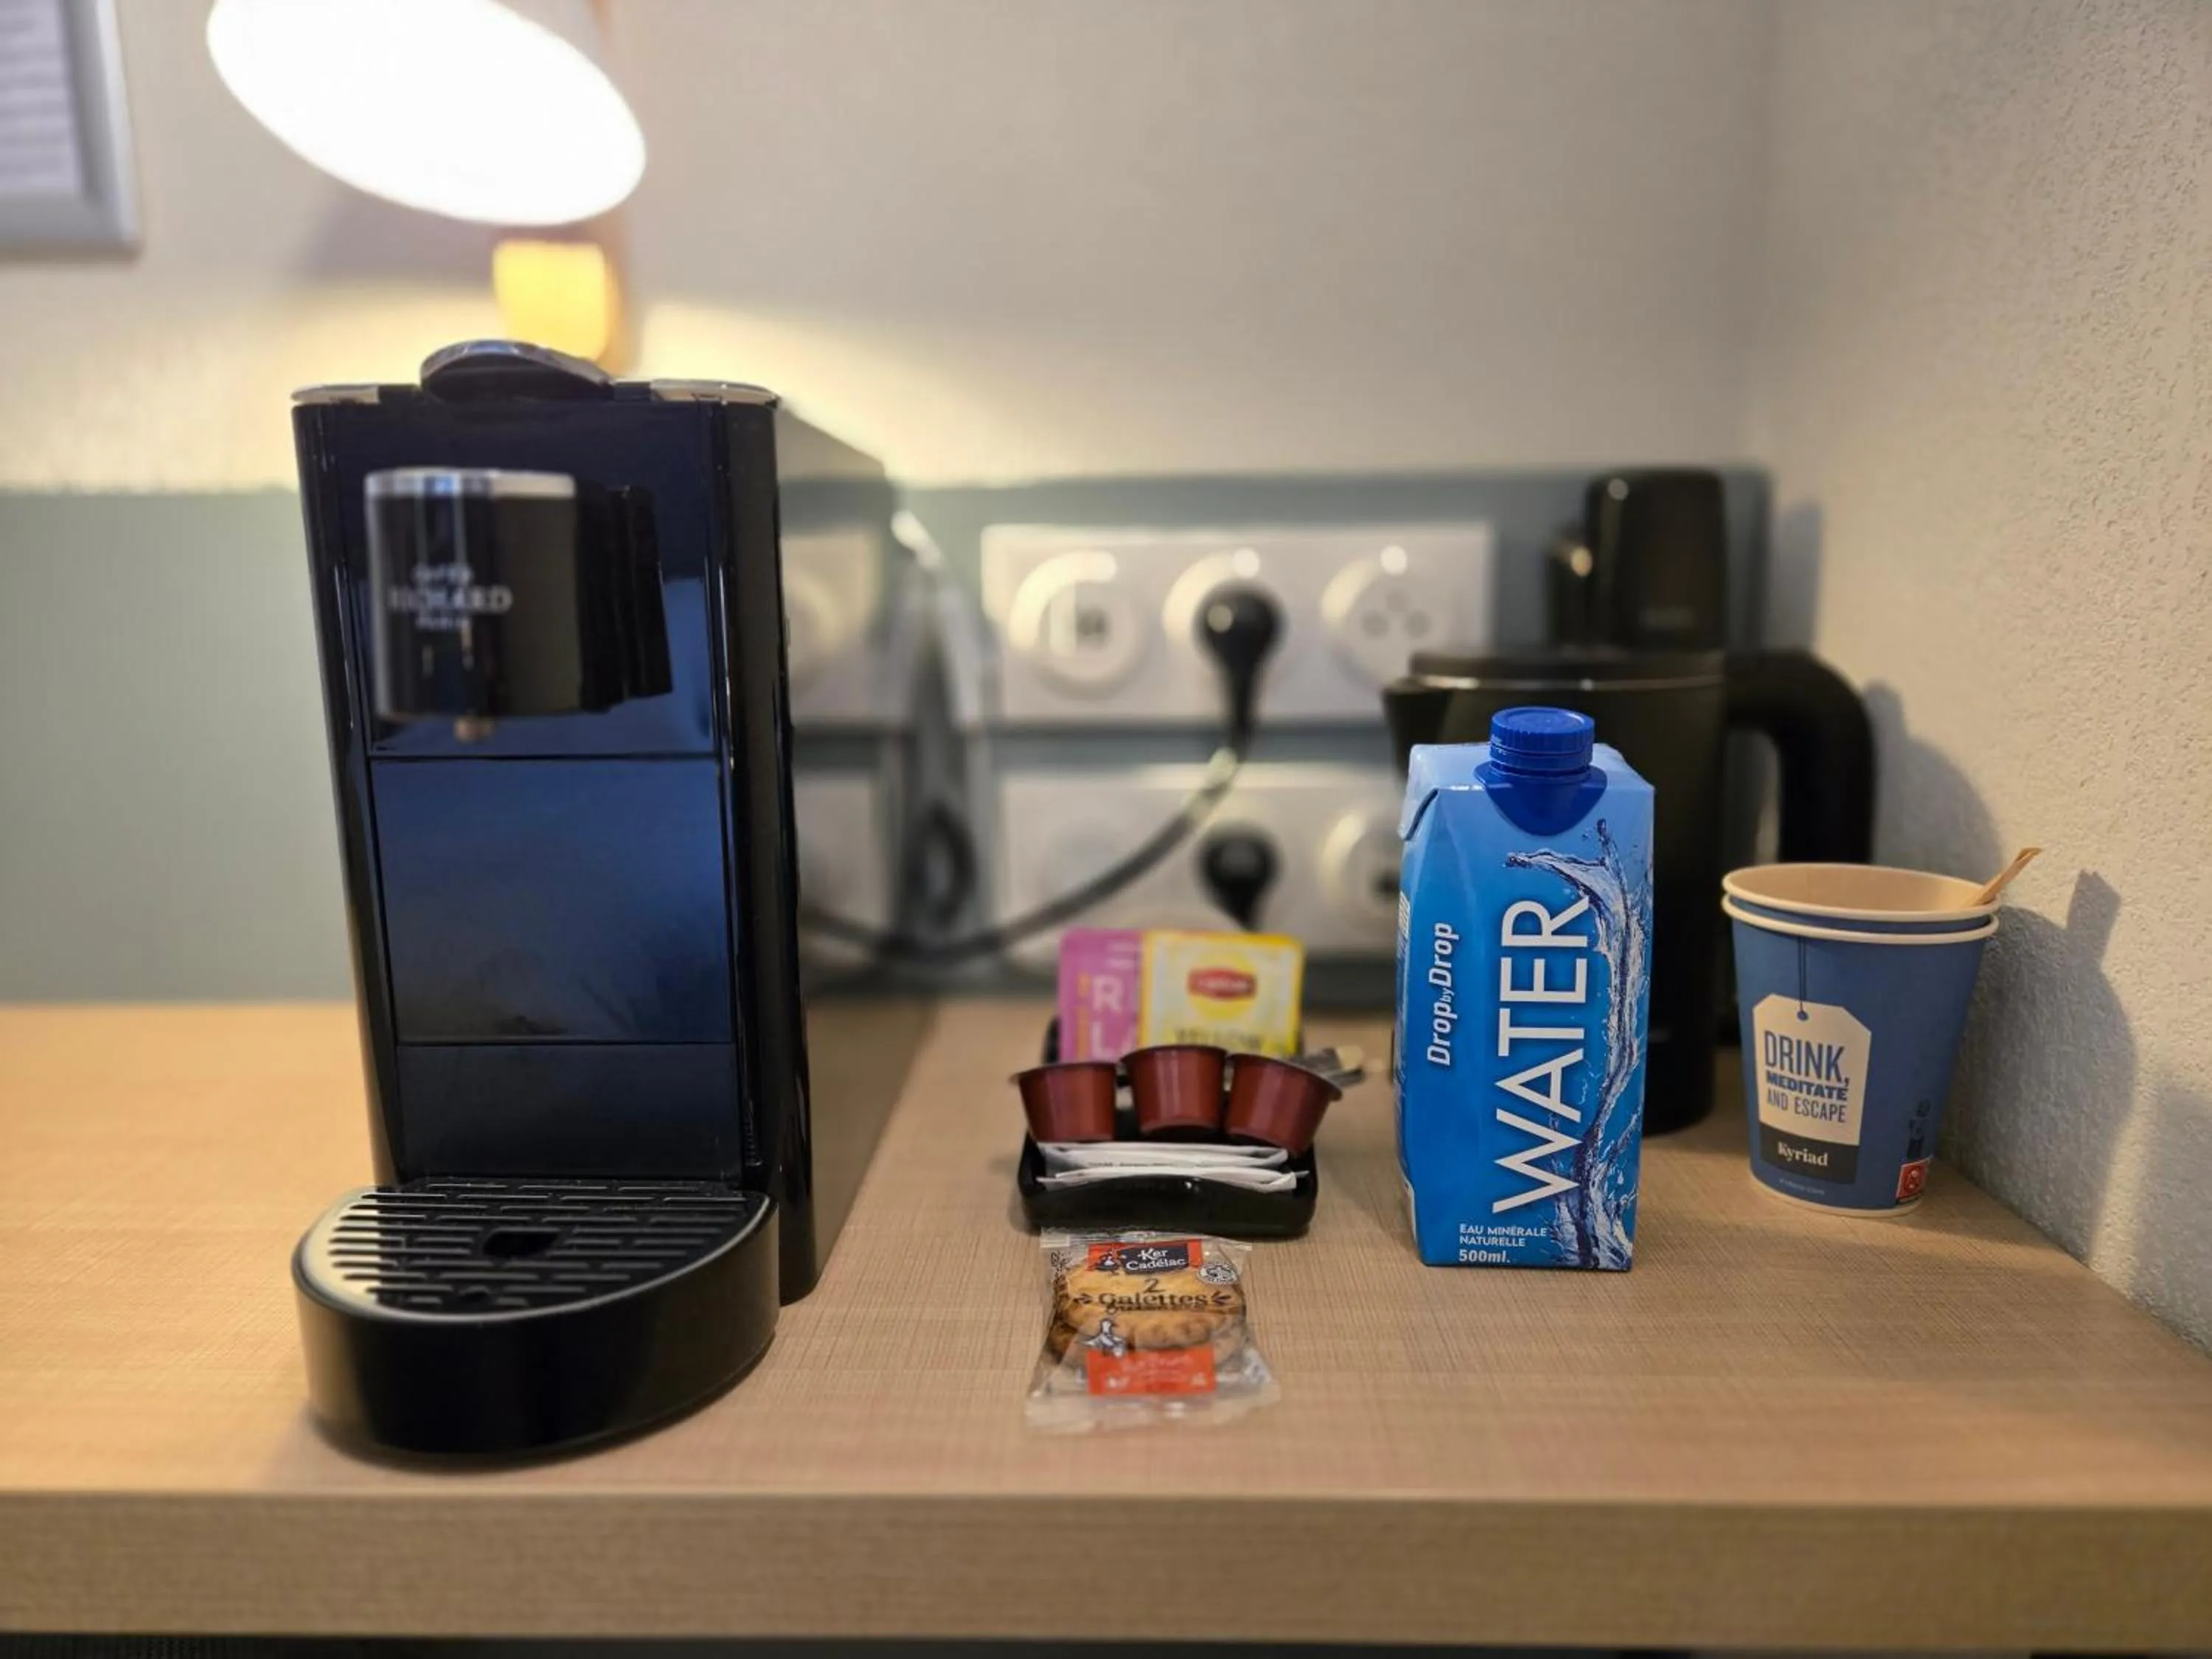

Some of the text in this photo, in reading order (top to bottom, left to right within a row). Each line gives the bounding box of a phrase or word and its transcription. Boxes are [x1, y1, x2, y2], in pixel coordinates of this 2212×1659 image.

[1492, 895, 1590, 1214] WATER
[1764, 1030, 1849, 1088] DRINK,
[1766, 1070, 1848, 1102] MEDITATE
[1767, 1089, 1847, 1124] AND ESCAPE
[1777, 1141, 1829, 1167] Kyriad
[1459, 1223, 1484, 1235] EAU
[1459, 1236, 1526, 1247] NATURELLE
[1125, 1257, 1187, 1271] Cadélac
[1137, 1247, 1169, 1261] Ker
[1144, 1277, 1166, 1293] 2
[1098, 1290, 1209, 1310] Galettes
